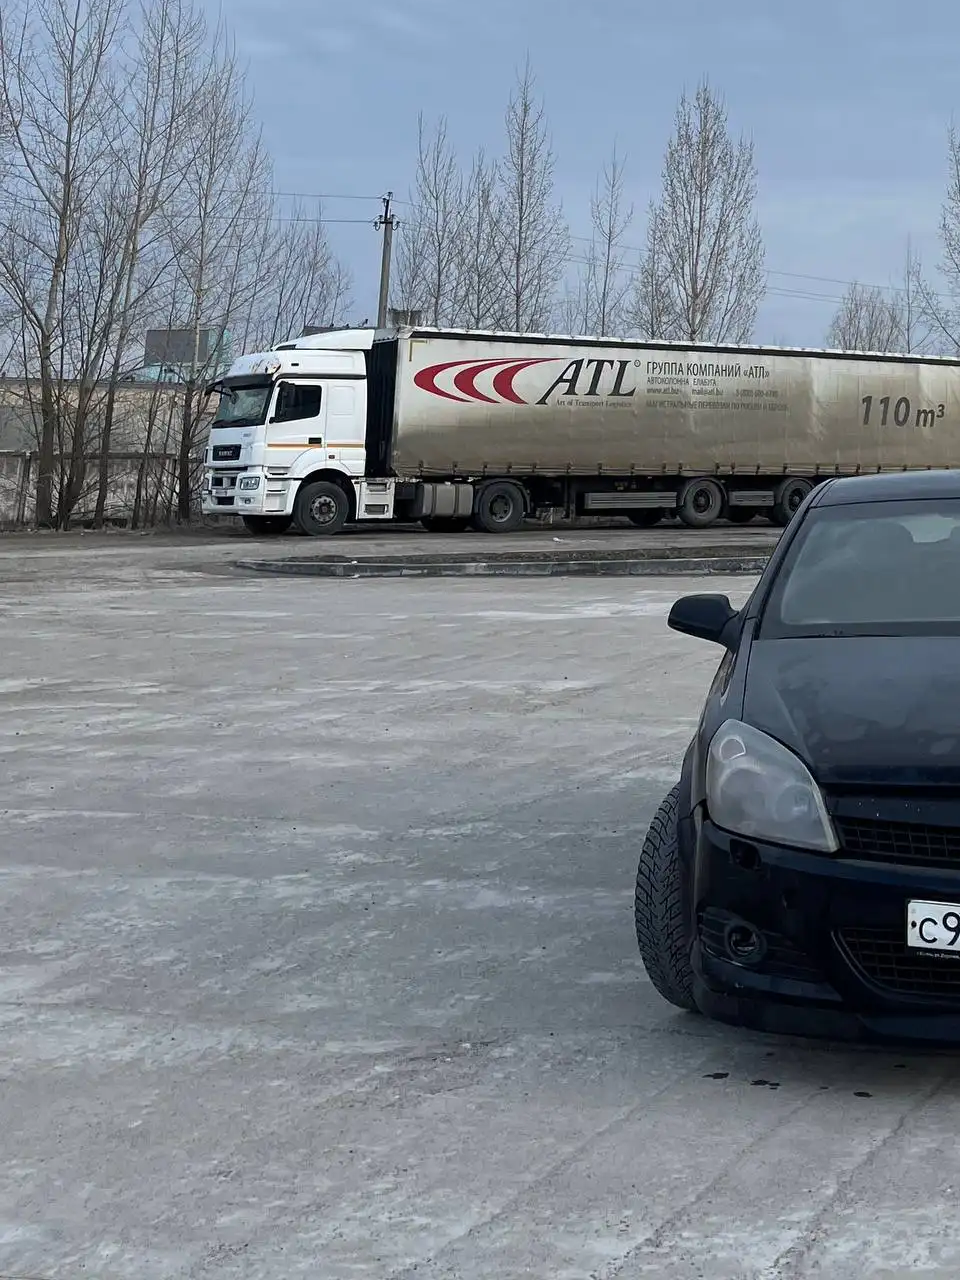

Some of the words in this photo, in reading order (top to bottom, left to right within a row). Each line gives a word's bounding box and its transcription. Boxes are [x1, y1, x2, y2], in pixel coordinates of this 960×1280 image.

[535, 358, 637, 405] ATL
[646, 361, 684, 376] ГРУППА
[686, 362, 741, 378] КОМПАНИЙ
[743, 365, 770, 380] «АТЛ»
[646, 376, 690, 385] АВТОКОЛОННА
[692, 378, 717, 387] ЕЛАБУГА
[862, 395, 911, 427] 110
